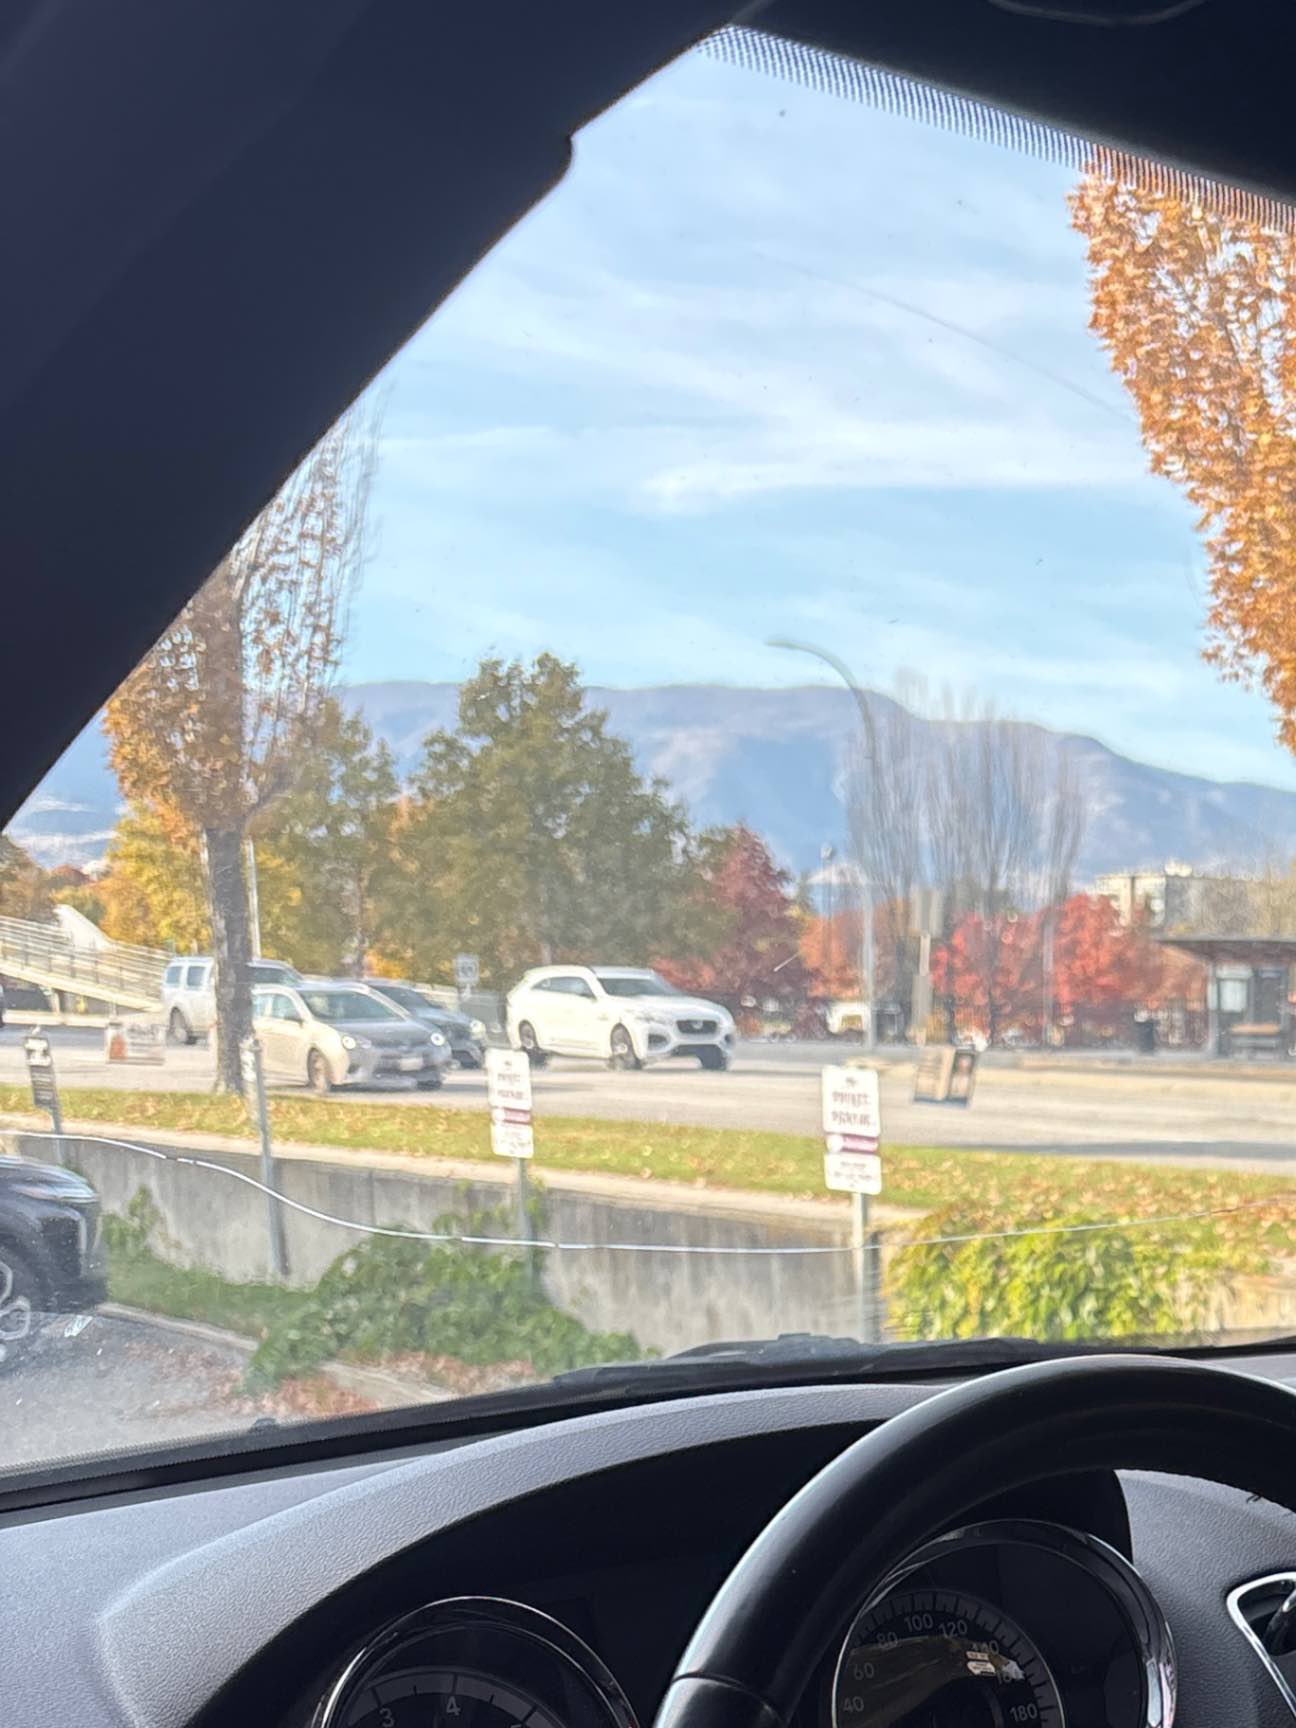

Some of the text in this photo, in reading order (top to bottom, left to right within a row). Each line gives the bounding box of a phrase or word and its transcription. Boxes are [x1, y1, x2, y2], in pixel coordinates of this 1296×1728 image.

[904, 1613, 934, 1633] 100
[938, 1618, 968, 1639] 120
[853, 1661, 875, 1681] 60
[445, 1696, 461, 1716] 4
[843, 1695, 865, 1712] 40
[1009, 1703, 1038, 1722] 180
[378, 1707, 396, 1728] 3
